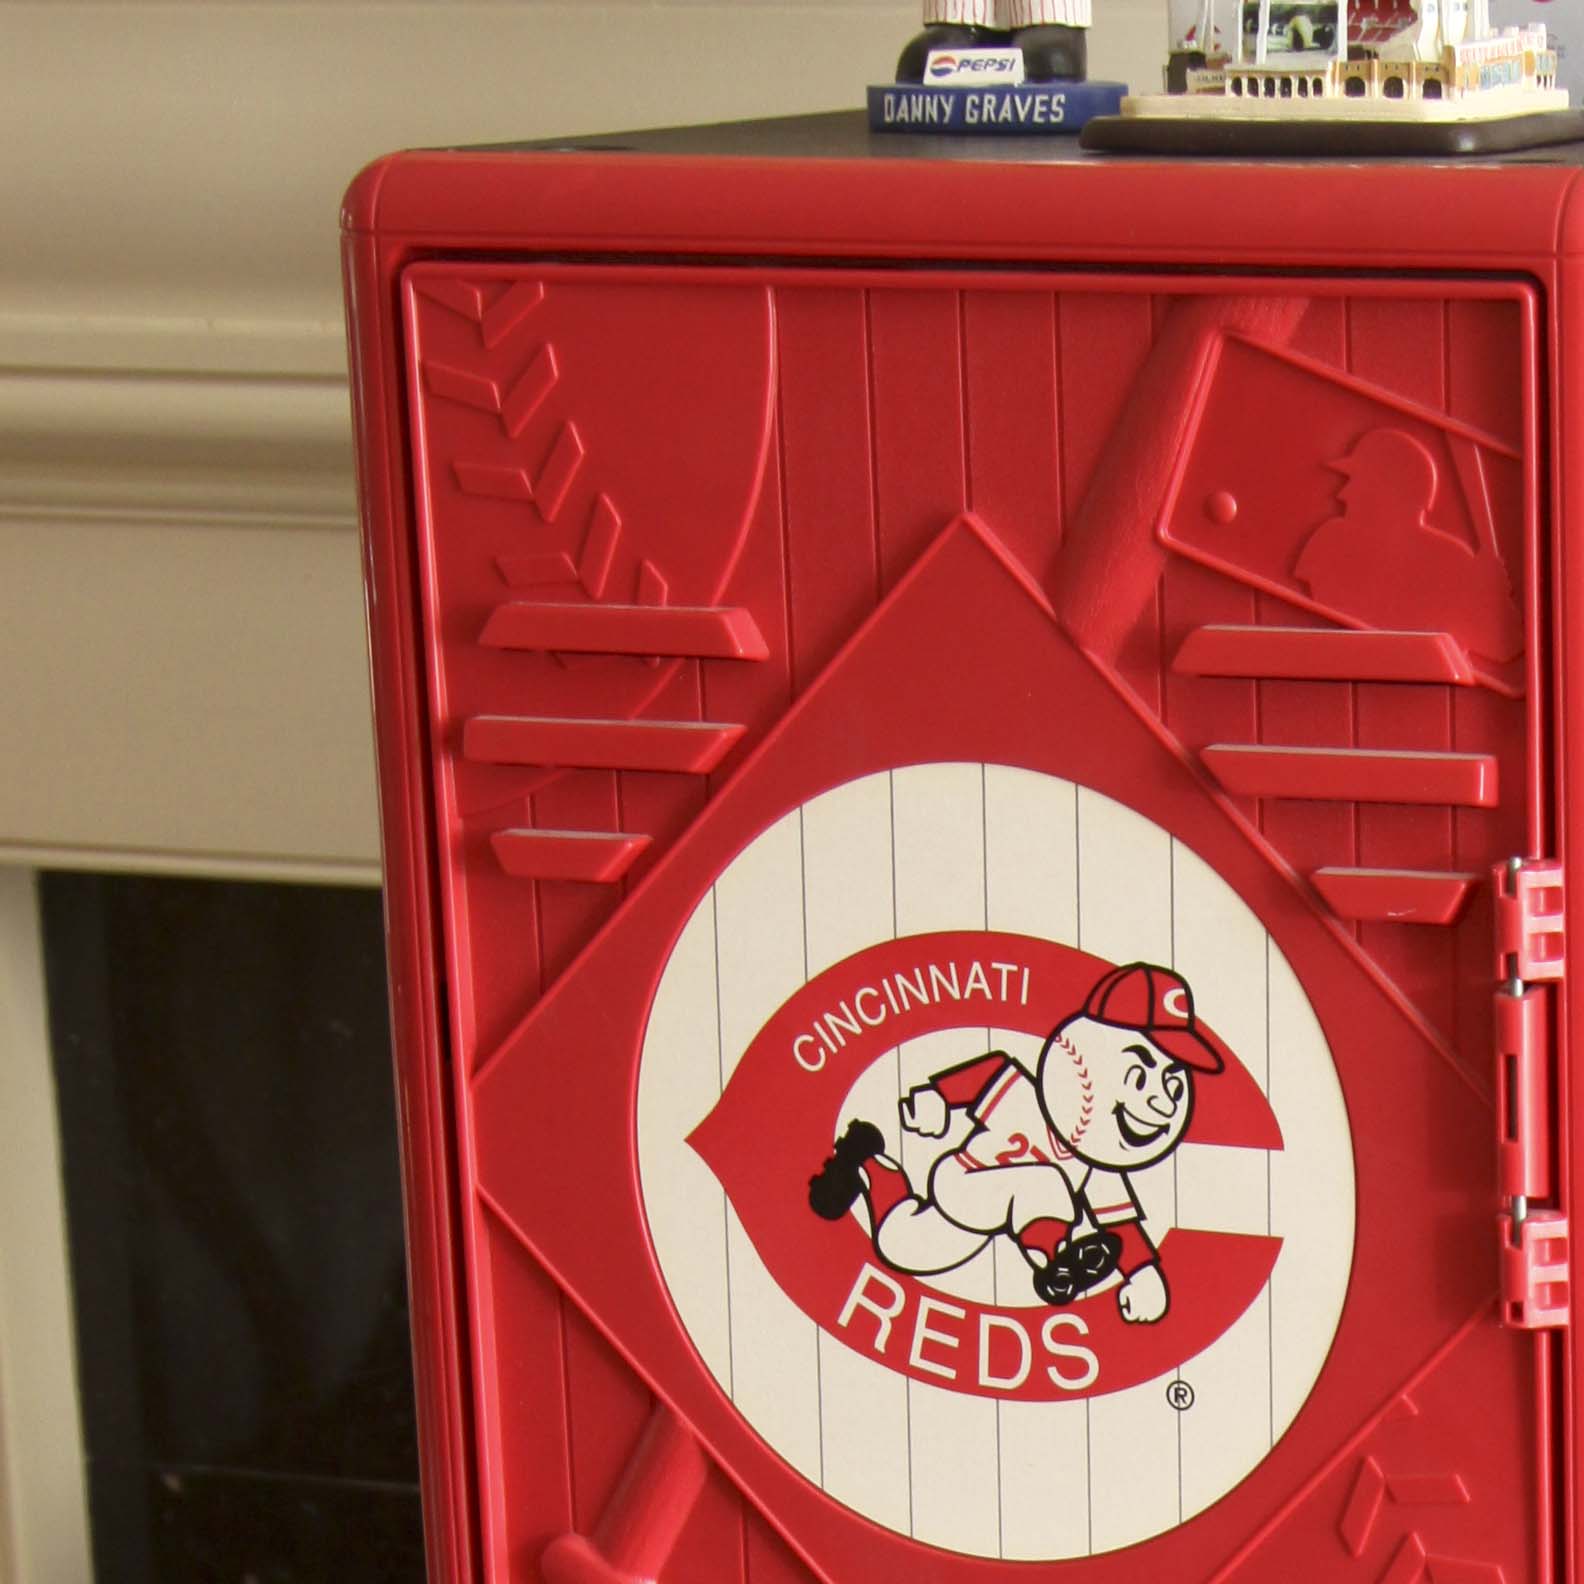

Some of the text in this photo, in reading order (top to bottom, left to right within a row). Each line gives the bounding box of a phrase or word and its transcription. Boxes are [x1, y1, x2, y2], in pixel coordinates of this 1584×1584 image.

[956, 58, 1016, 72] PEPSI
[883, 93, 1066, 125] DANNY GRAVES
[792, 960, 1032, 1073] CINCINNATI
[836, 1261, 1101, 1392] REDS
